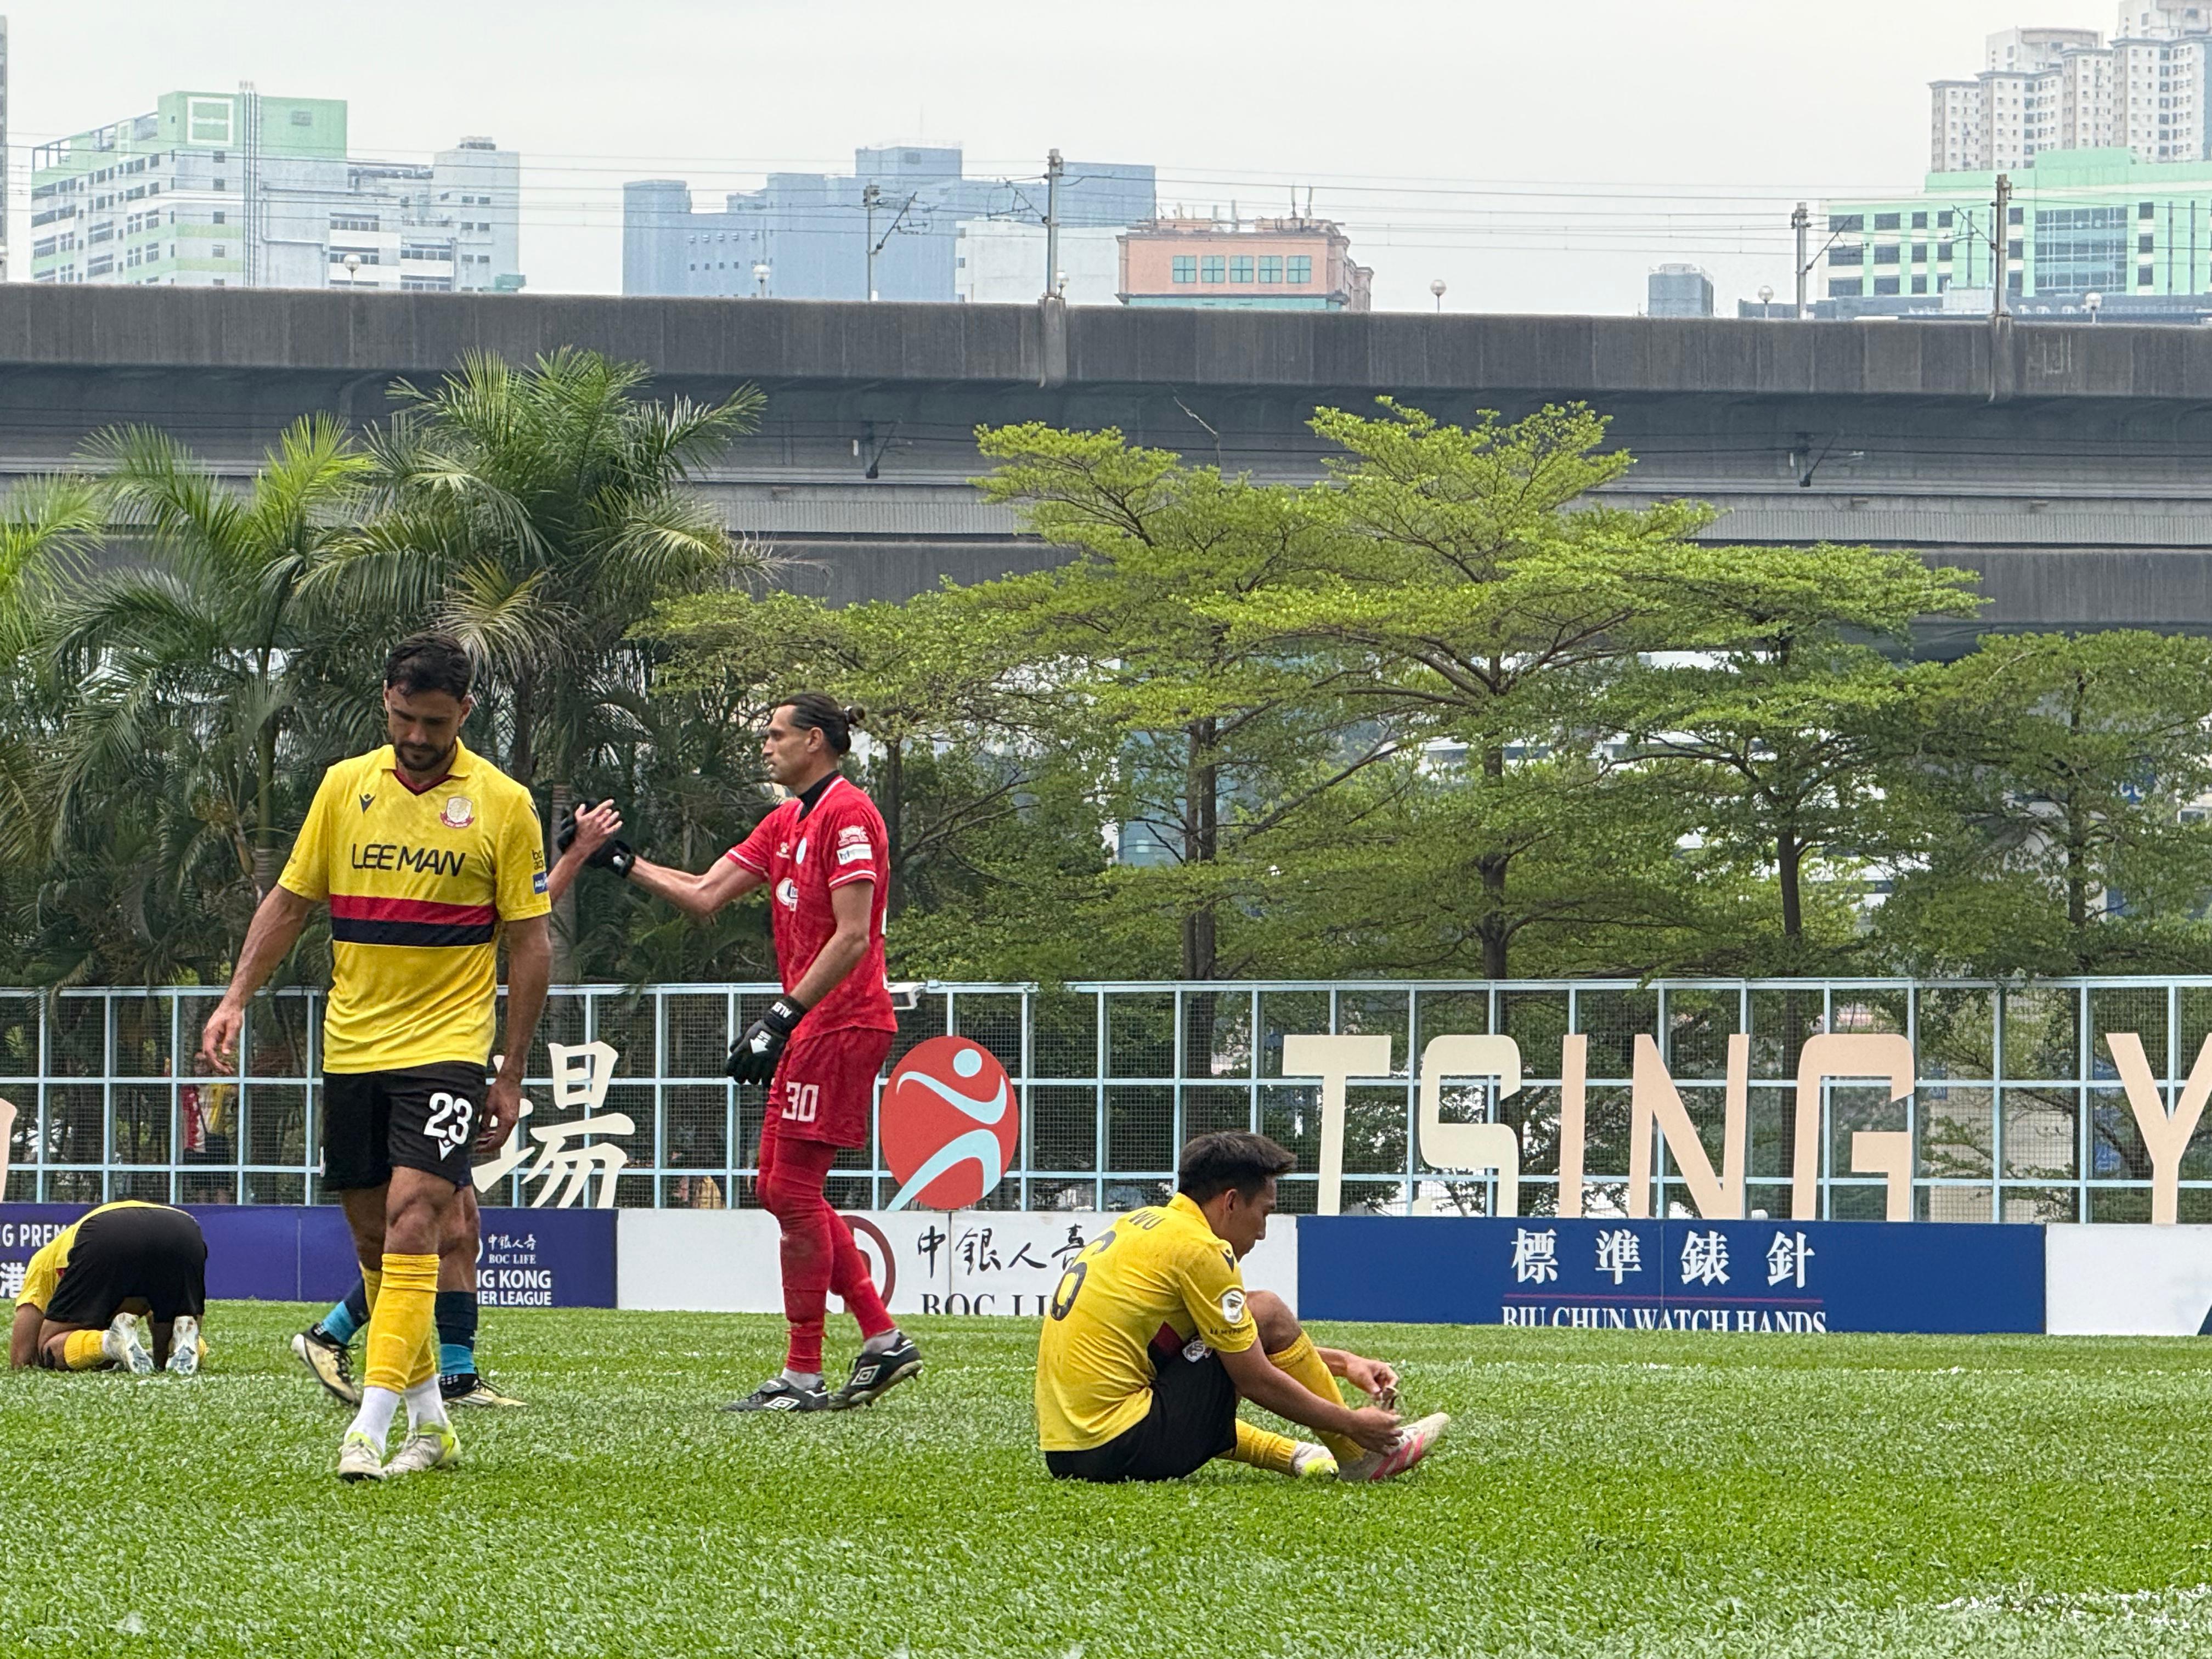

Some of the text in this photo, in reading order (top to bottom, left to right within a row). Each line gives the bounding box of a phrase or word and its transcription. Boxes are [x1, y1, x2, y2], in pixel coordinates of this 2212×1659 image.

[423, 1092, 473, 1146] 23
[781, 1081, 820, 1123] 30
[471, 1041, 635, 1208] 場
[1283, 1034, 1914, 1222] TSING
[1128, 1210, 1166, 1231] WU
[488, 1254, 537, 1265] BOC LIFE
[1510, 1227, 1816, 1289] 標準錶針
[499, 1269, 552, 1289] KONG
[1050, 1230, 1117, 1321] 6
[500, 1290, 552, 1306] LEAGUE
[921, 1293, 996, 1316] BOC
[1552, 1307, 1627, 1329] CHUN
[1632, 1308, 1731, 1332] WATCH
[1736, 1310, 1827, 1334] HANDS
